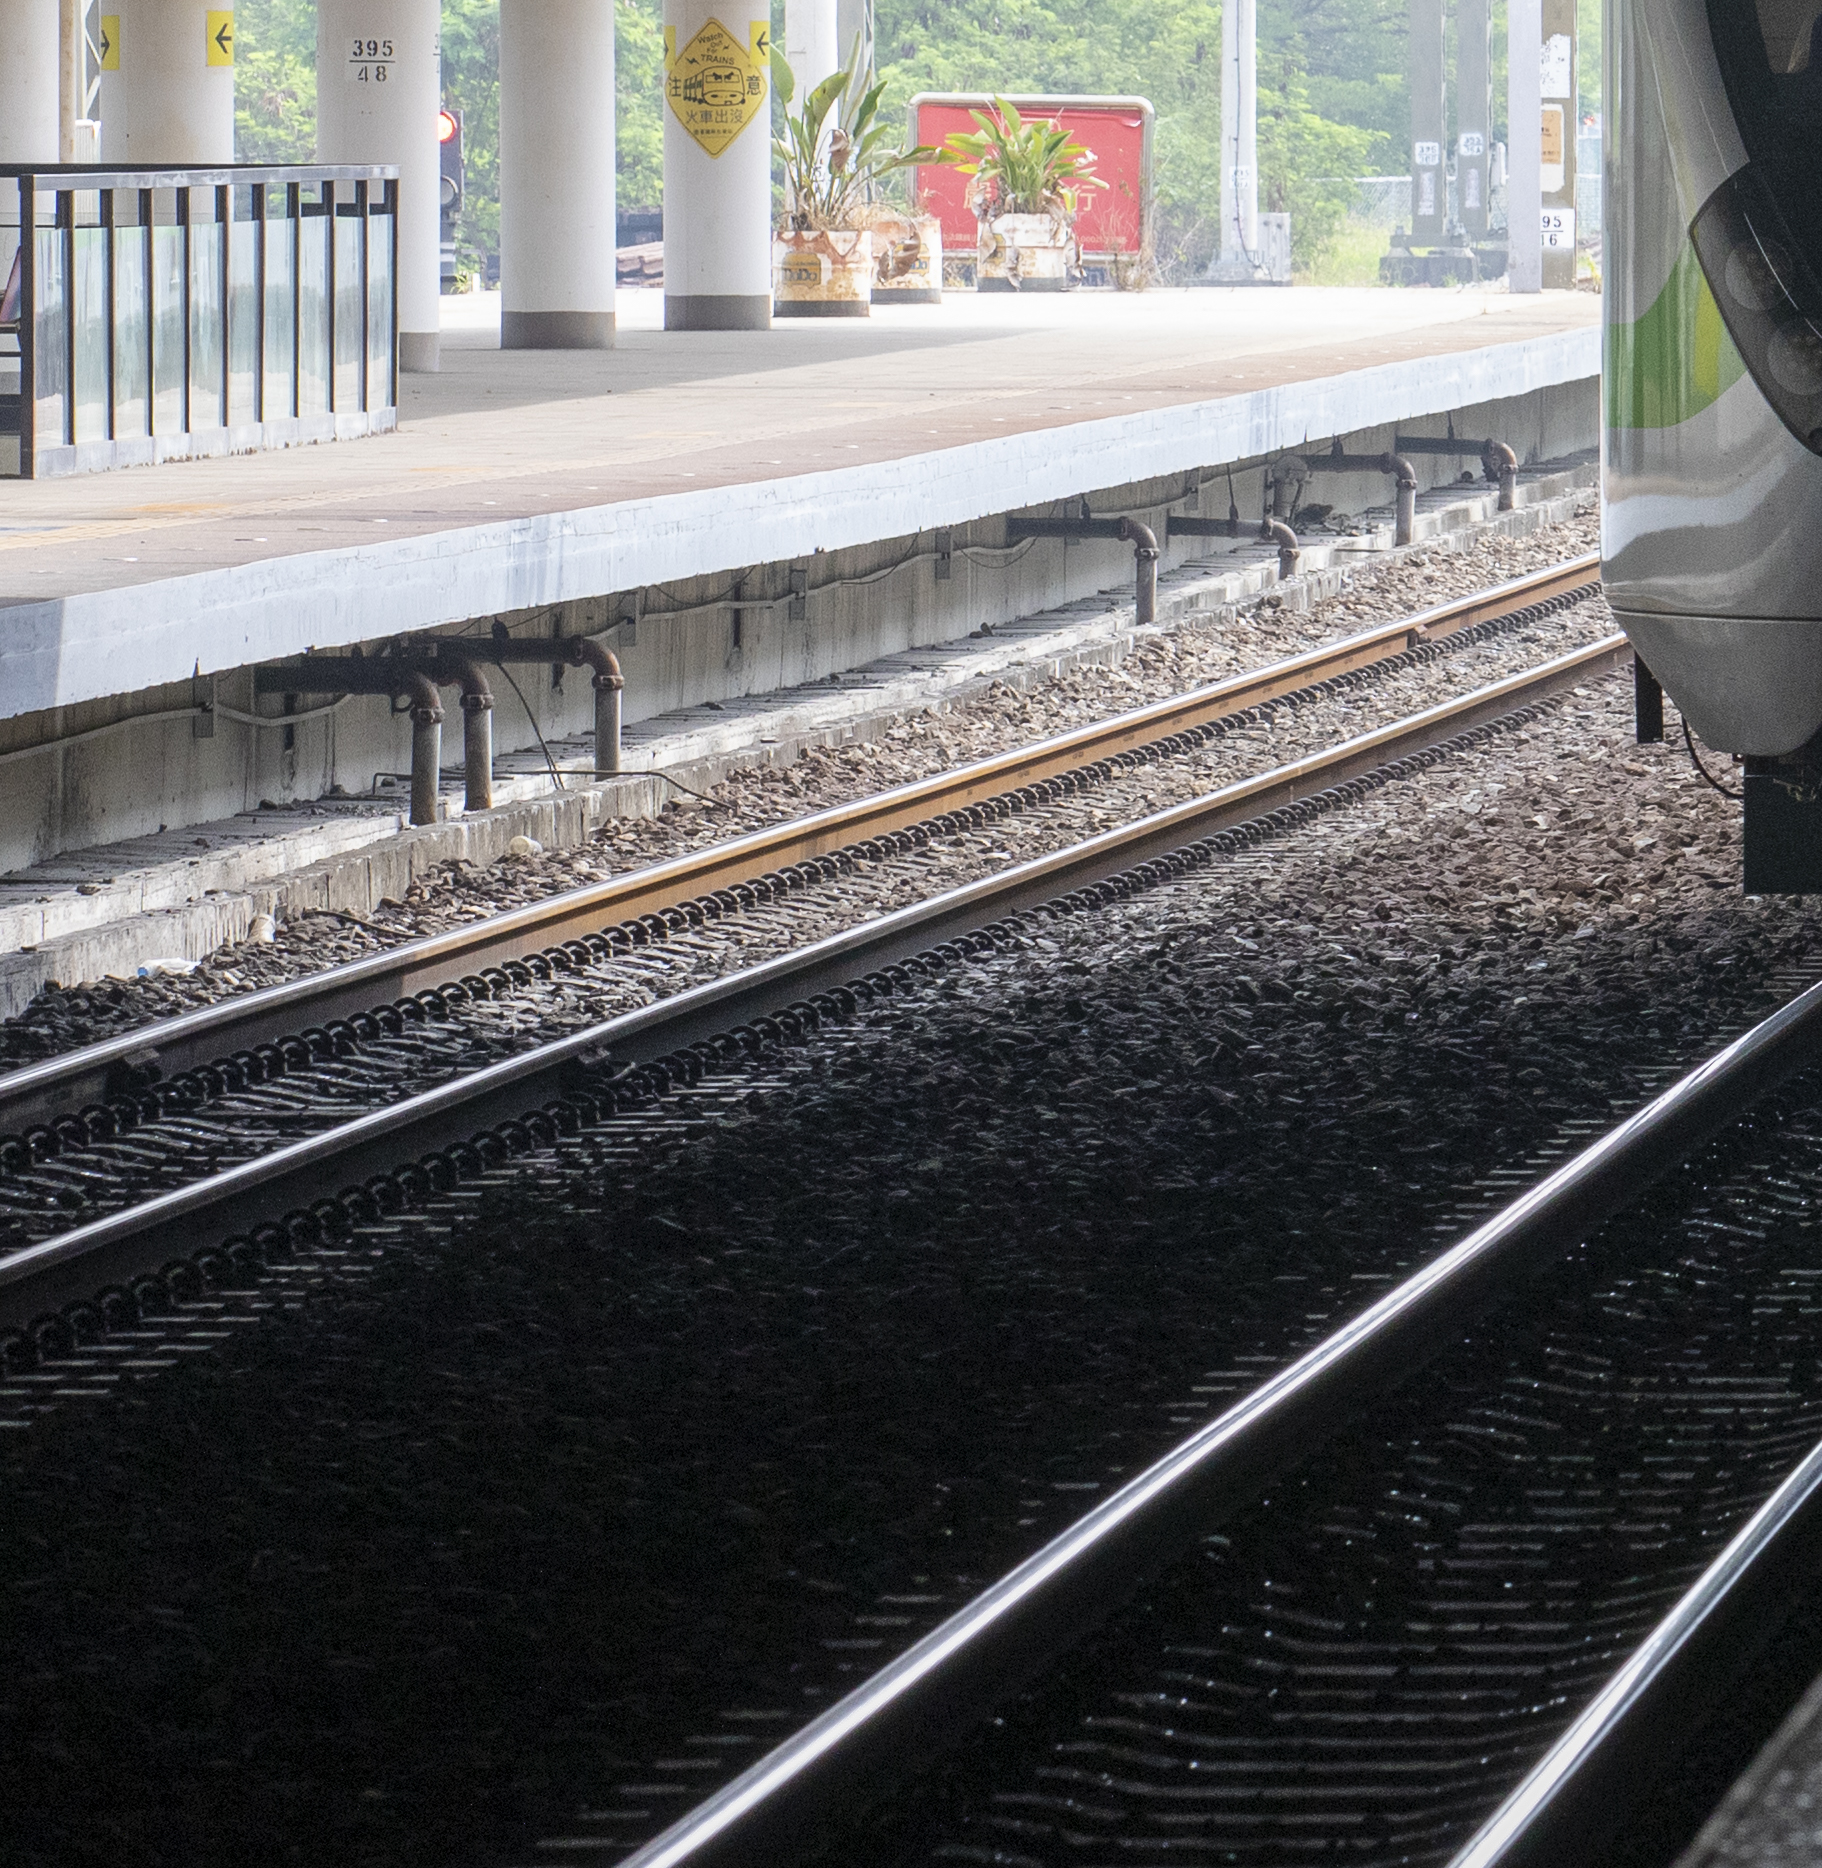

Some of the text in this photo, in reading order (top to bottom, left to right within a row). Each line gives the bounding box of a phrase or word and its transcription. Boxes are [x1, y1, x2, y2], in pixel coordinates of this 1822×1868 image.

[697, 32, 724, 44] Watch
[352, 39, 394, 58] 395
[700, 53, 735, 66] TRAINS
[357, 65, 388, 83] 48
